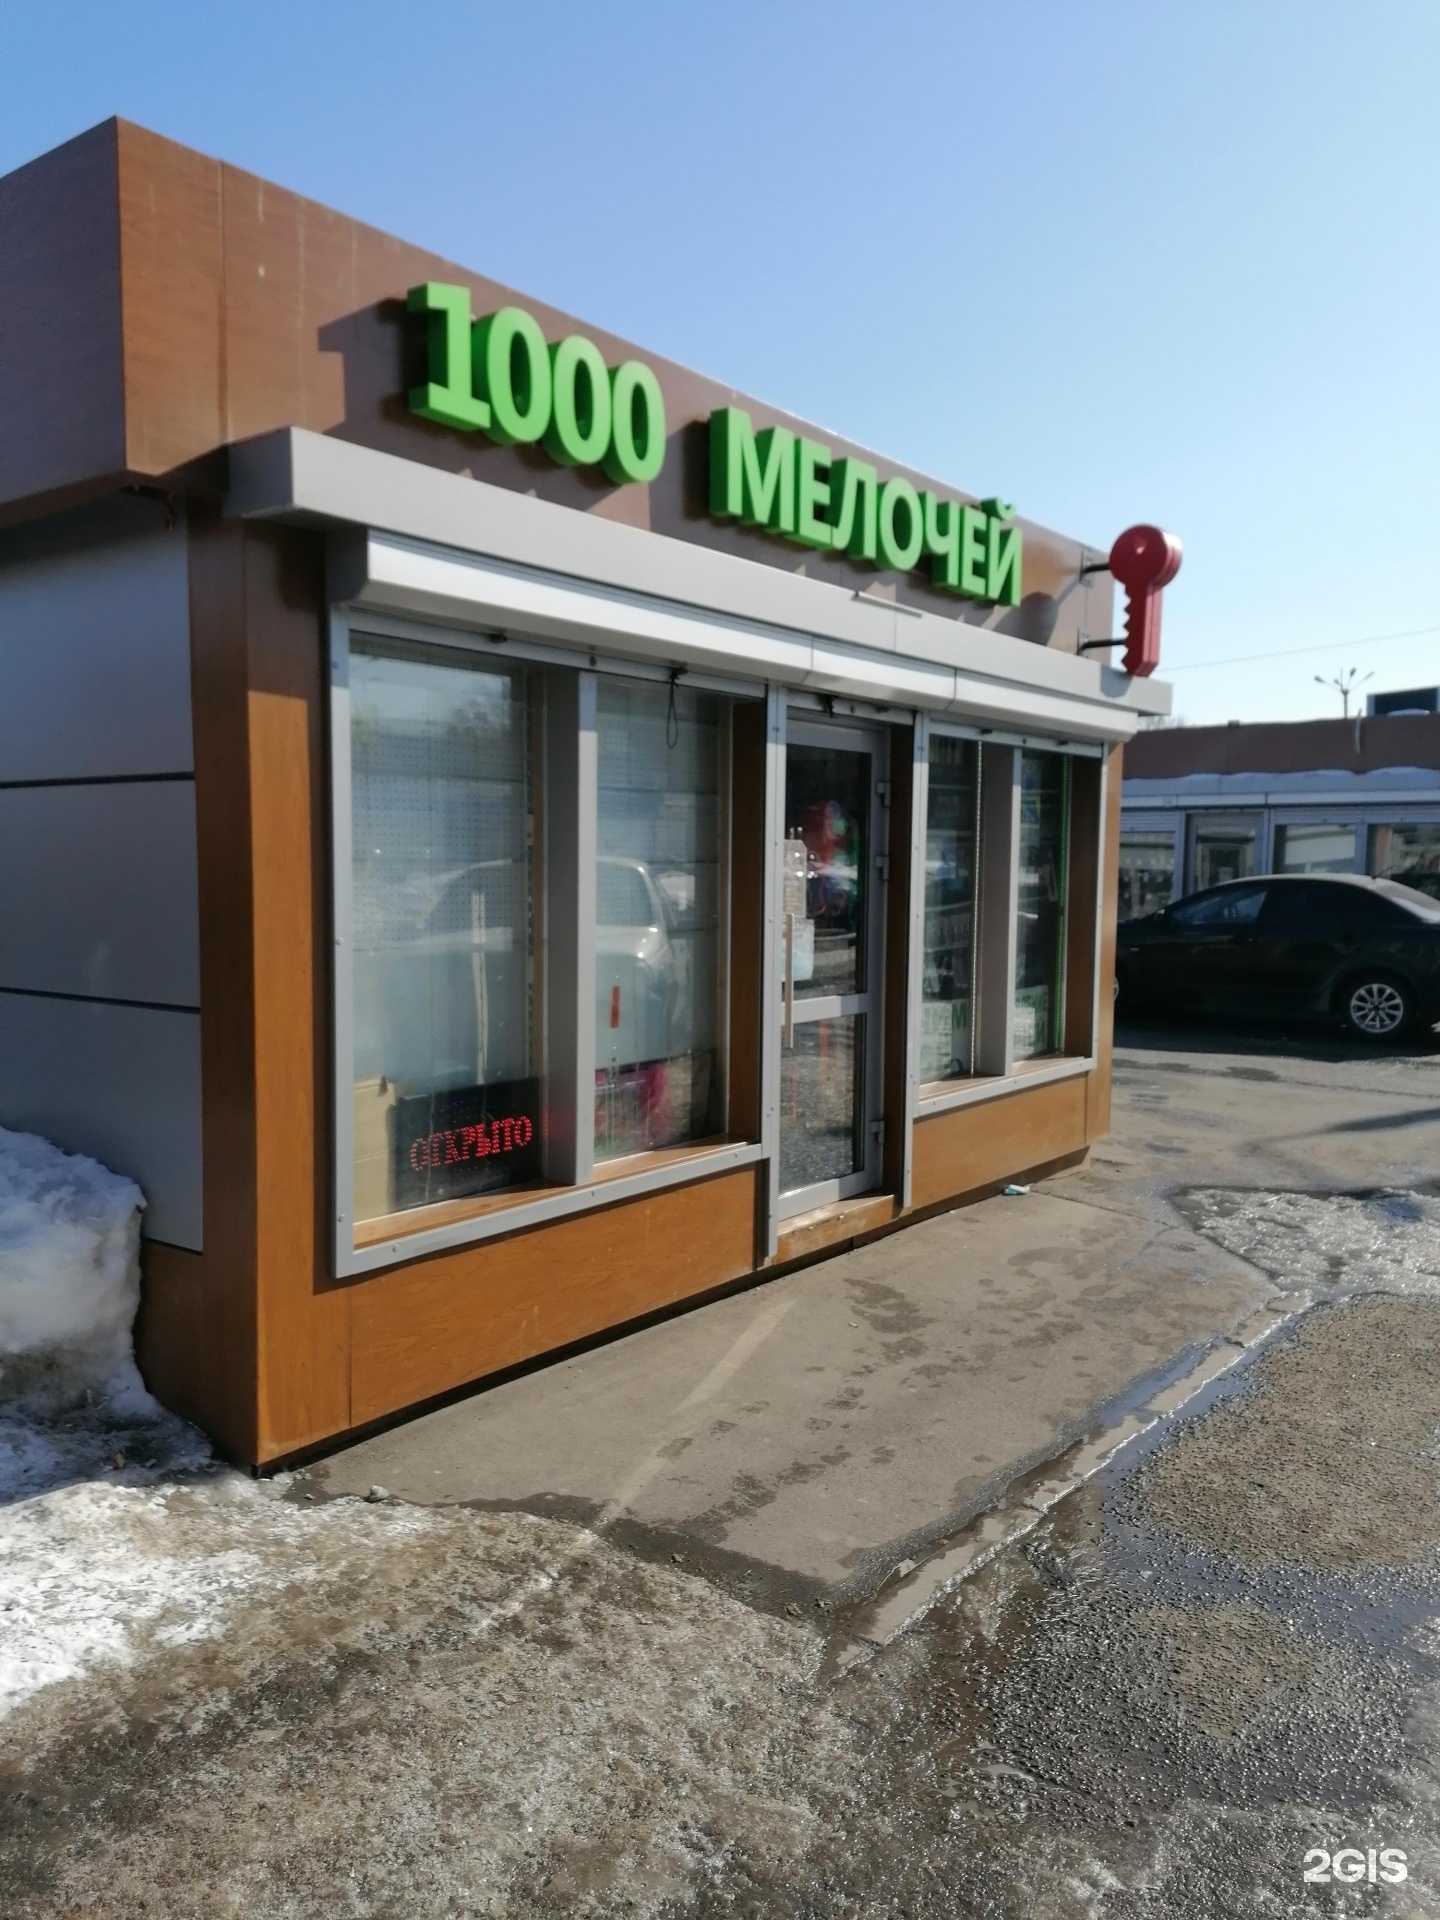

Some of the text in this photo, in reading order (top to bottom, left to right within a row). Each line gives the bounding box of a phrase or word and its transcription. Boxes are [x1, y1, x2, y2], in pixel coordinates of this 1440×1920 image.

[407, 281, 1023, 607] 1000 МЕЛОЧЕЙ
[409, 1114, 533, 1172] ОТКРЫТО
